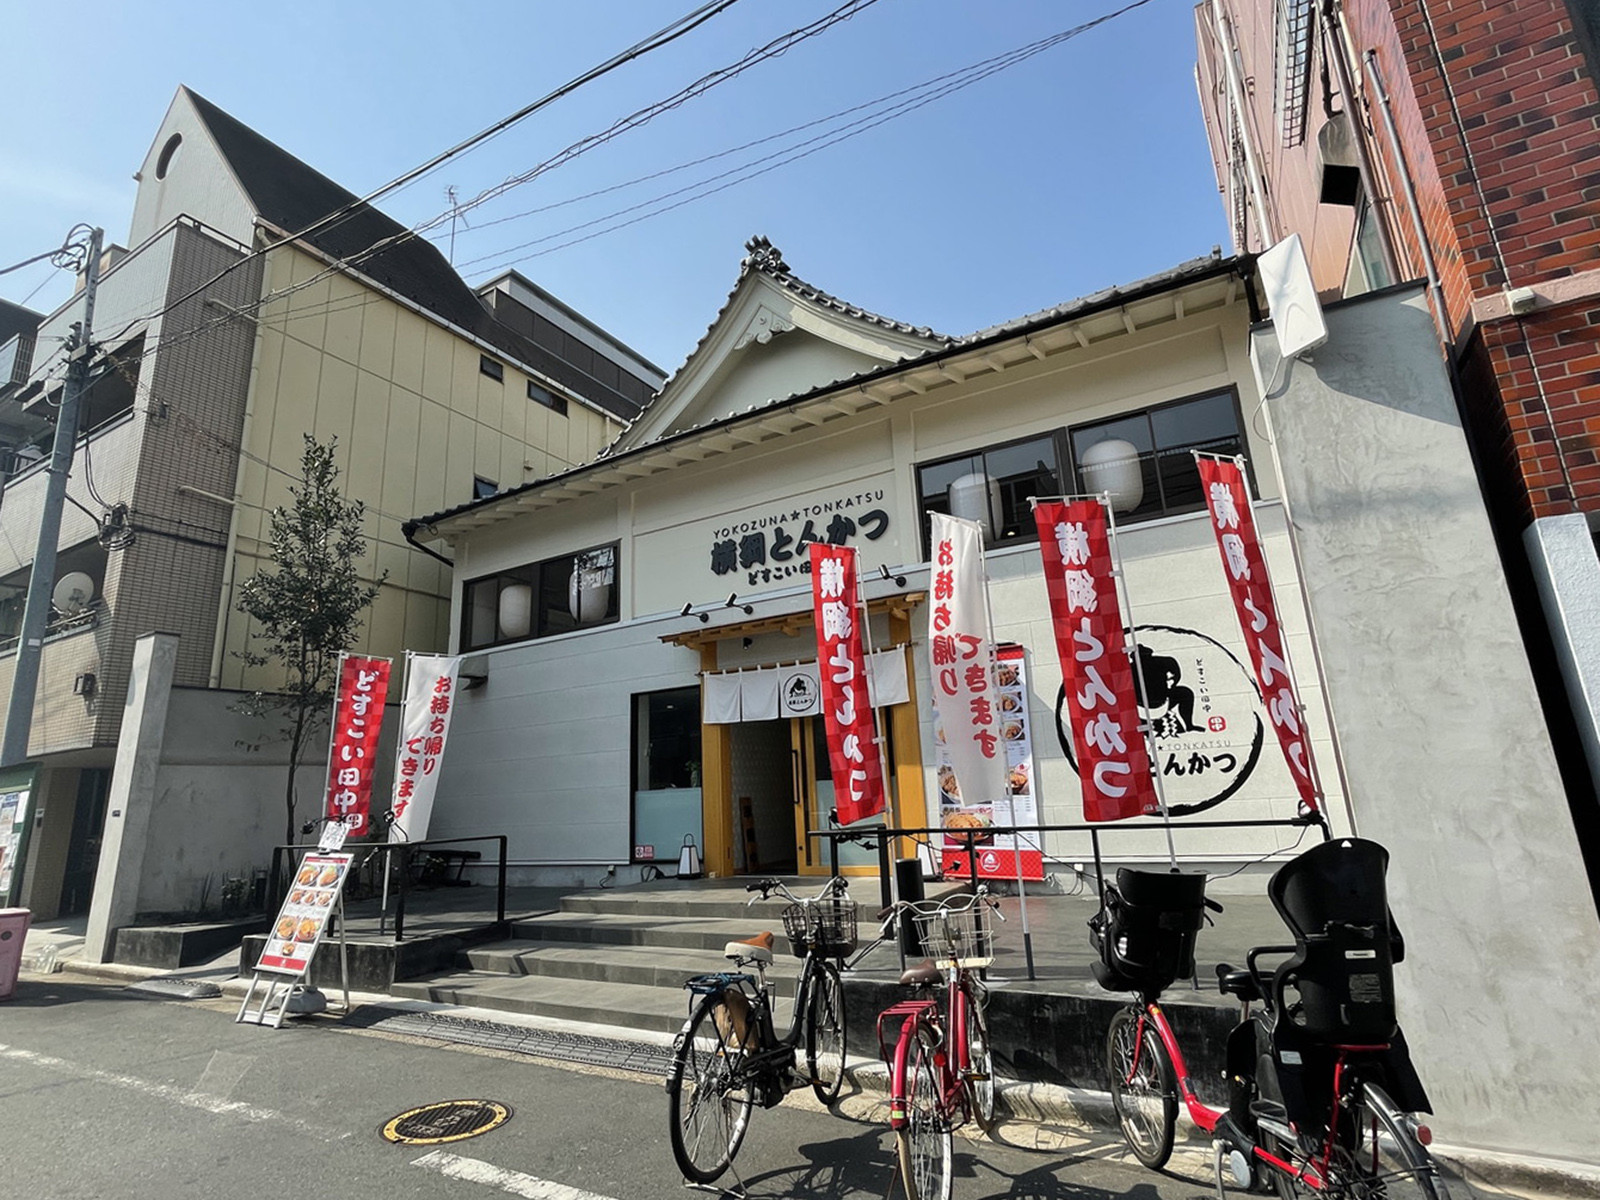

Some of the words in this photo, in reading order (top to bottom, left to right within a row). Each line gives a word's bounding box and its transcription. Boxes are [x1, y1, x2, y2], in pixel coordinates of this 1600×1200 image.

[713, 513, 788, 539] YOKOZUNA
[803, 490, 884, 518] TONKATSU
[334, 670, 379, 813] どすこい田中
[423, 676, 451, 775] お持ち帰り
[1167, 740, 1231, 751] TONKATSU
[393, 736, 425, 819] できます
